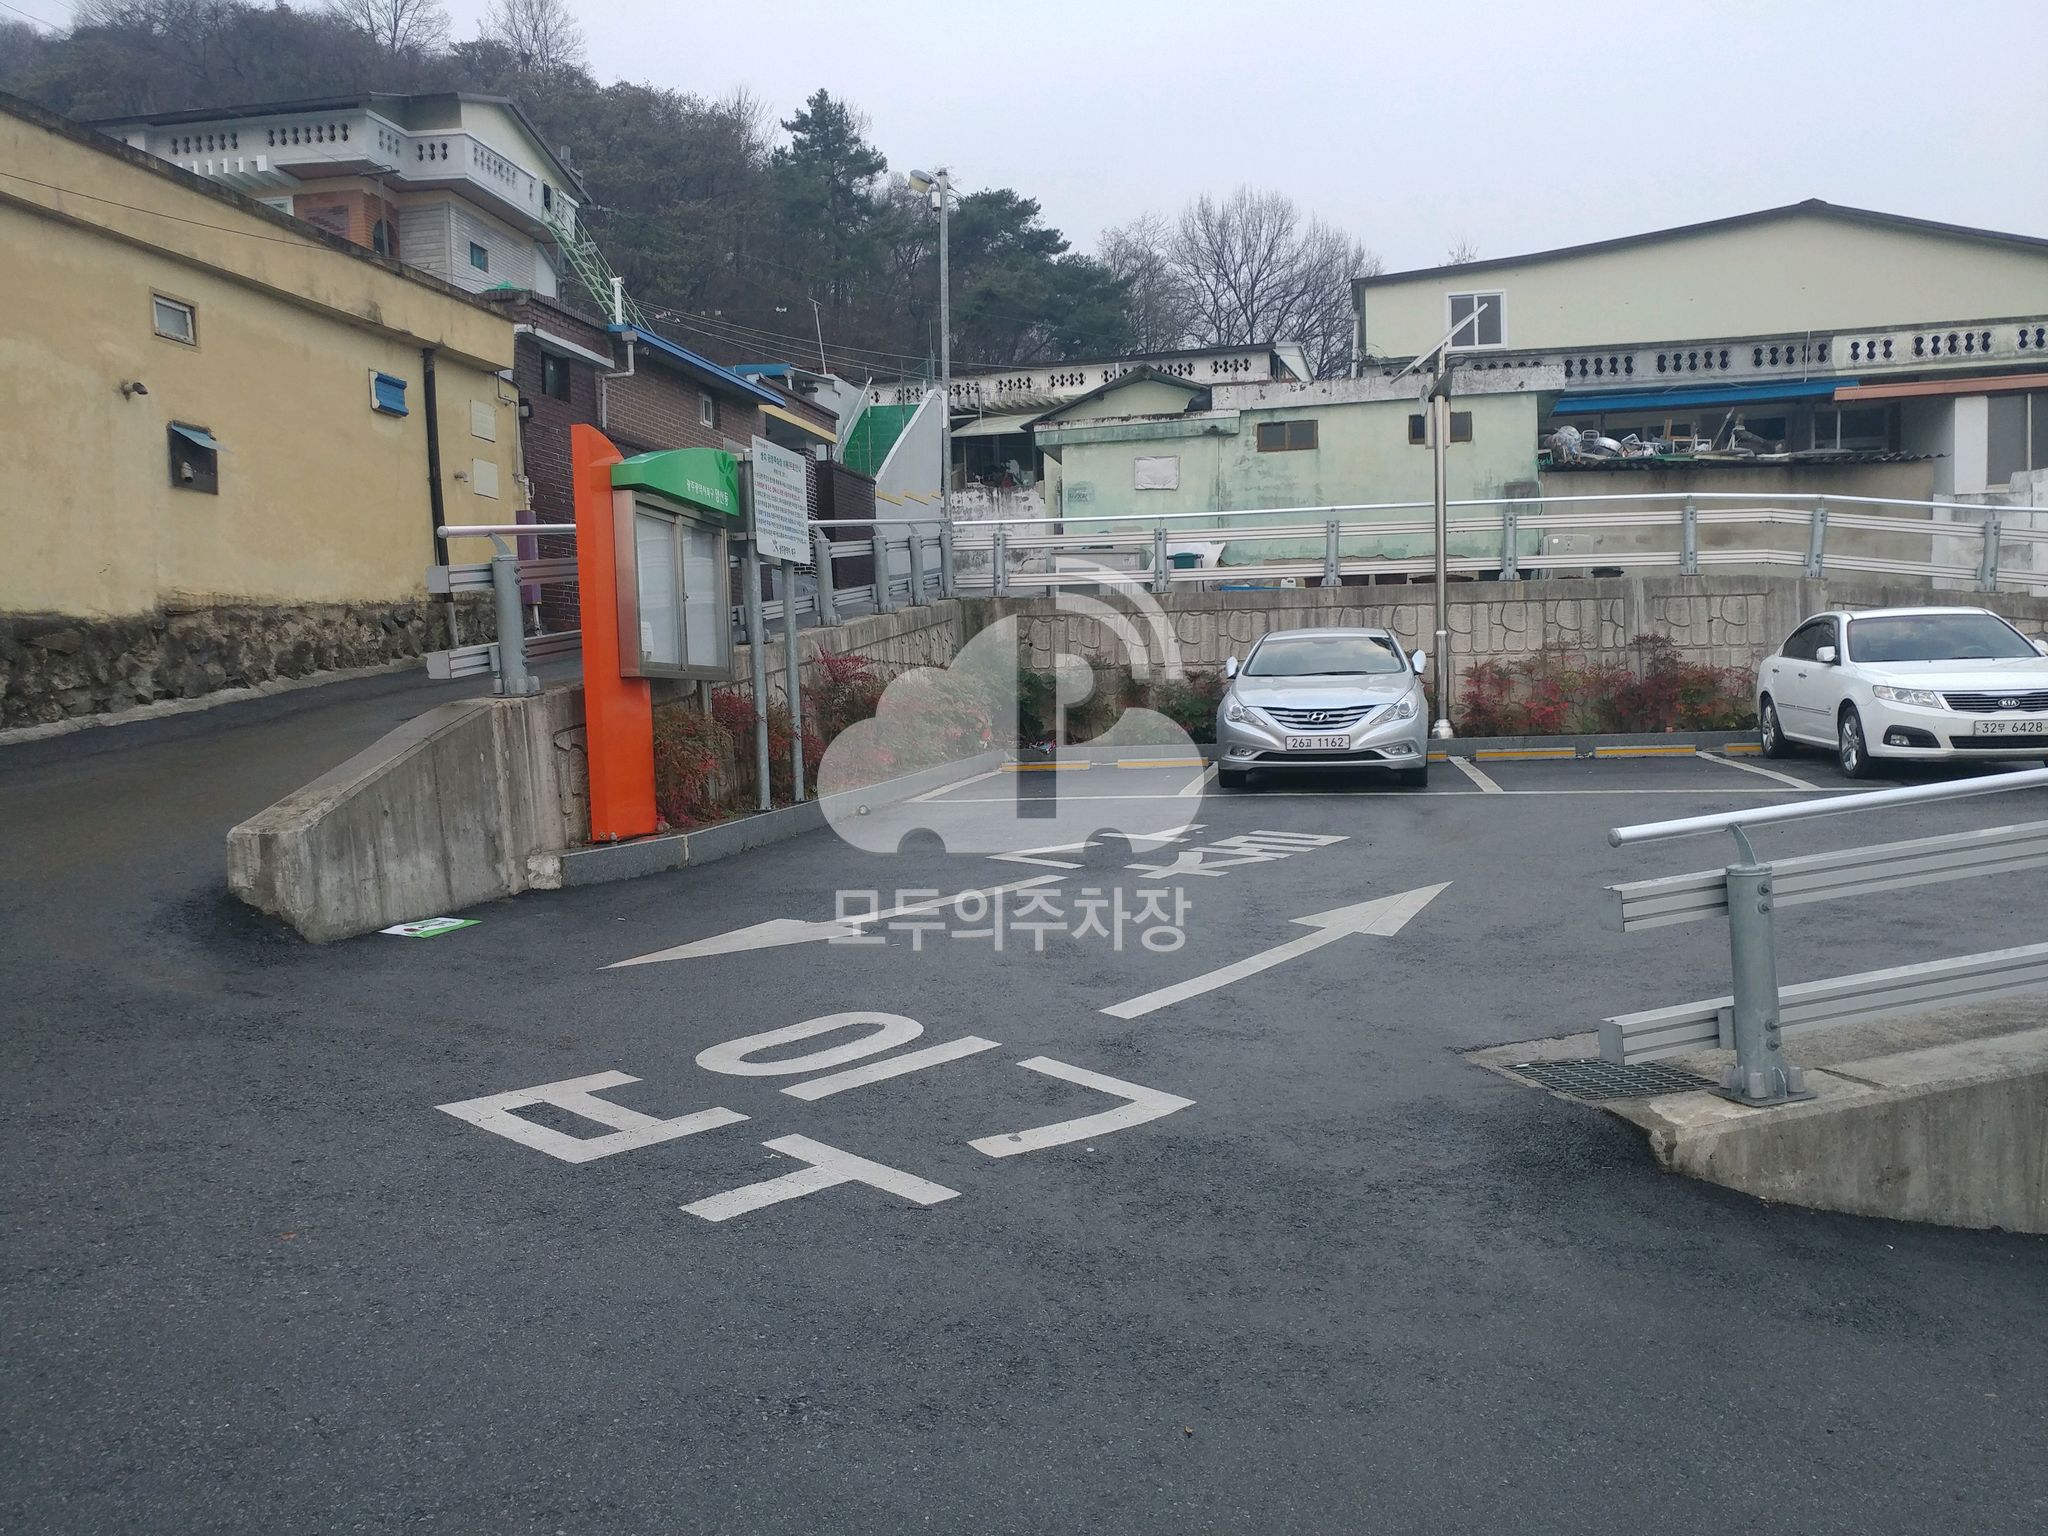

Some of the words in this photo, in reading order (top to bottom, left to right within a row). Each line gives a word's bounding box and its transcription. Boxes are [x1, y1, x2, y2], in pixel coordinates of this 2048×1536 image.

[1982, 722, 2006, 734] 32무
[2011, 721, 2043, 733] 6428
[1292, 738, 1312, 748] 26고
[1317, 737, 1344, 748] 1162
